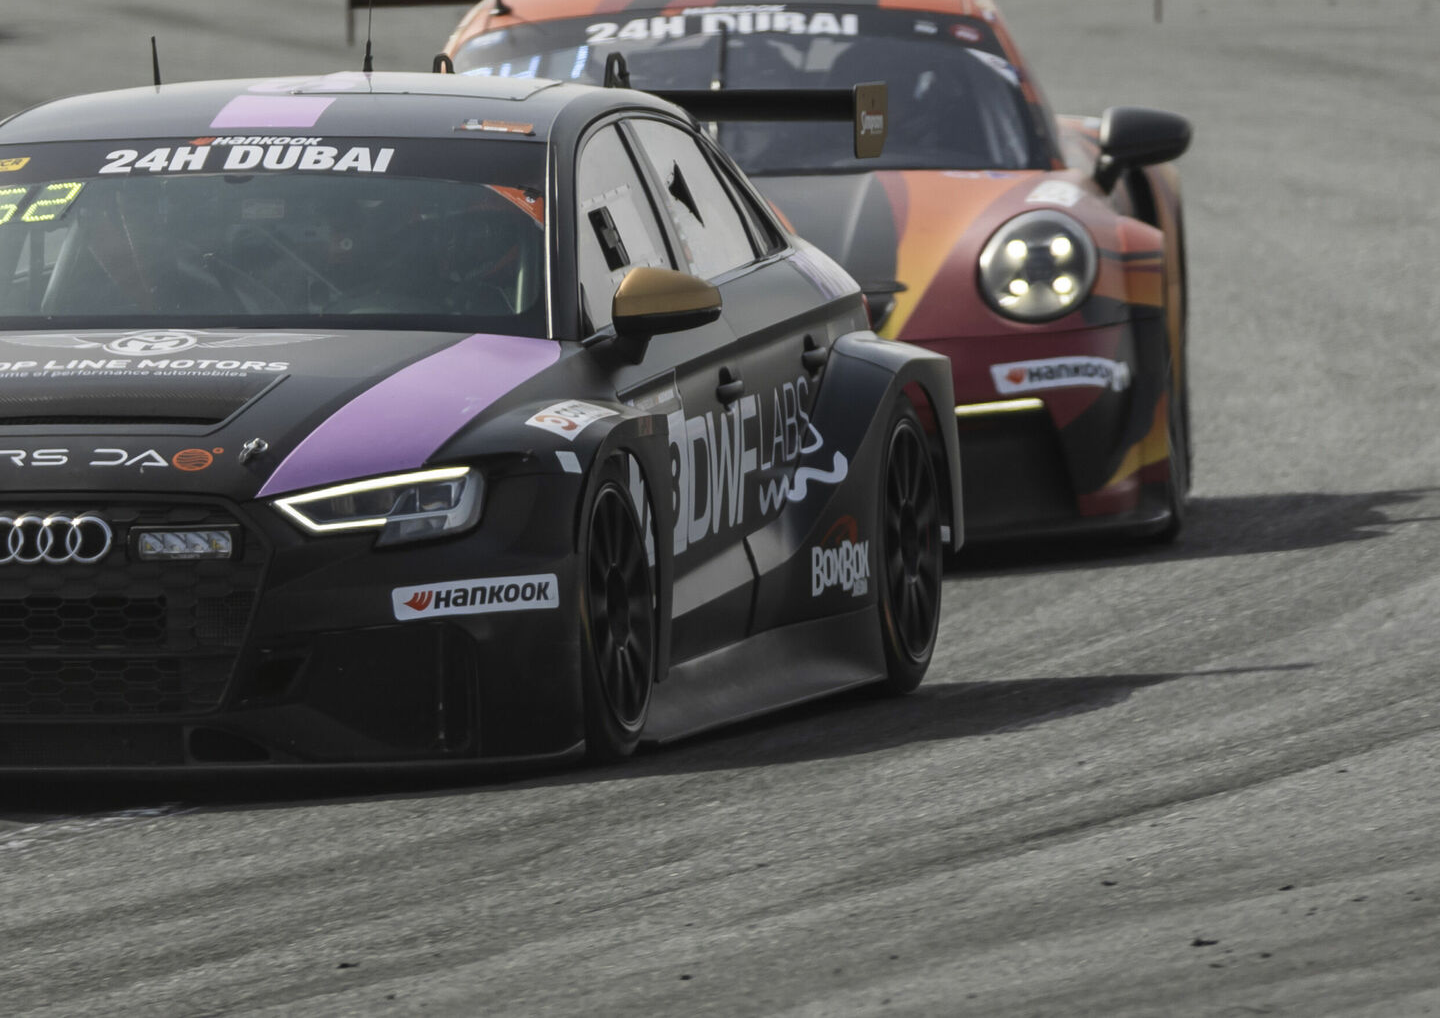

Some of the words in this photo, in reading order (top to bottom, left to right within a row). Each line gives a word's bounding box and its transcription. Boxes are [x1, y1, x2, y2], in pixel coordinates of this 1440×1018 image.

[585, 16, 687, 44] 24H
[702, 11, 859, 36] DUBAI
[98, 146, 212, 174] 24H
[222, 145, 396, 173] DUBAI
[42, 358, 132, 370] LINE
[136, 359, 291, 372] MOTORS
[50, 368, 145, 379] performance
[146, 369, 248, 378] automobiles
